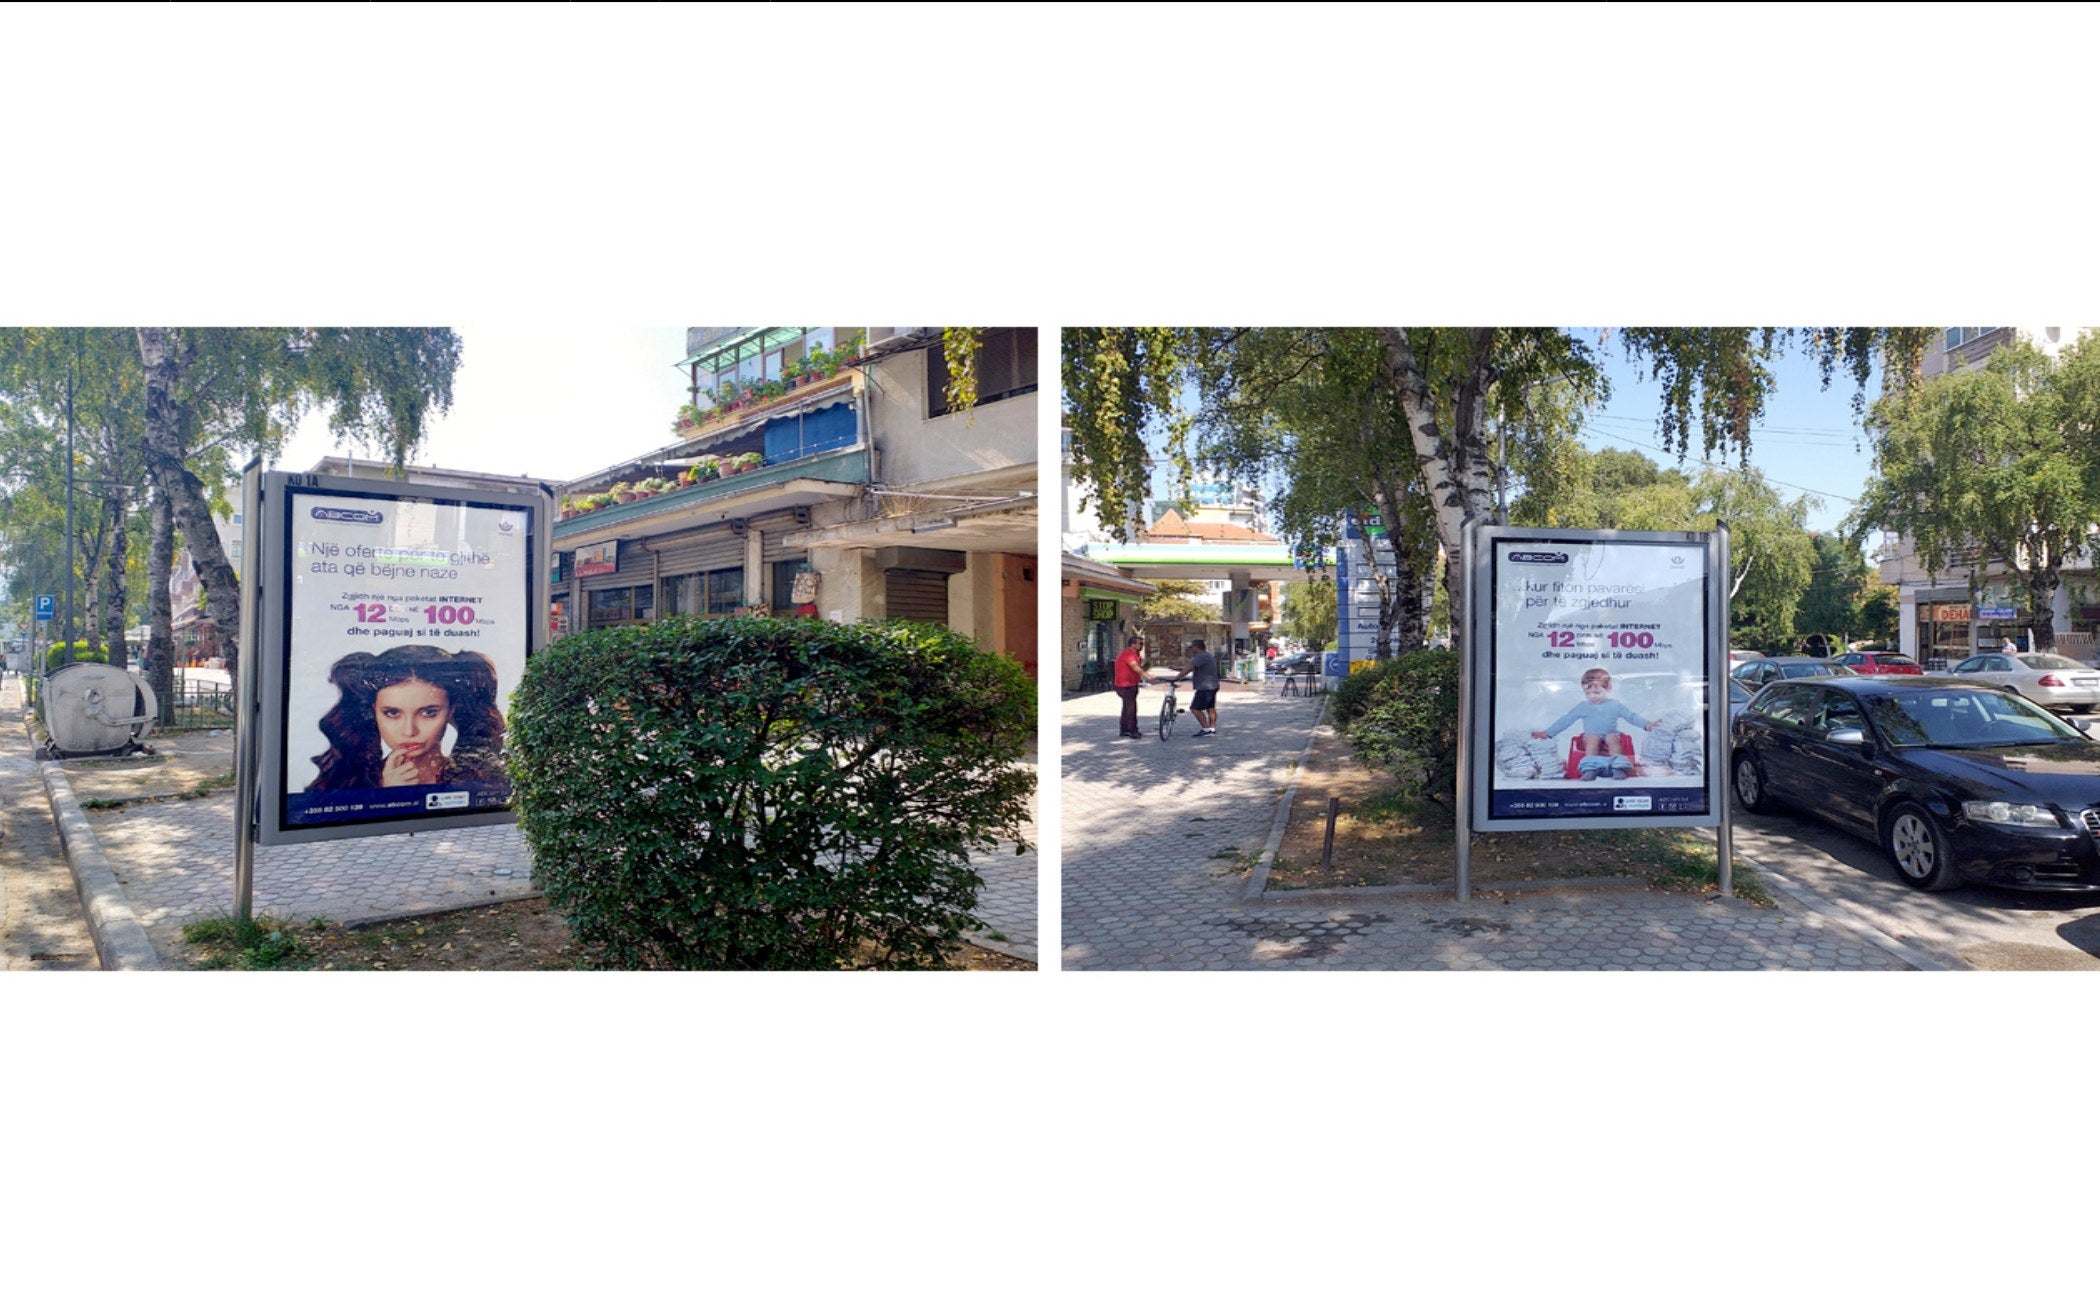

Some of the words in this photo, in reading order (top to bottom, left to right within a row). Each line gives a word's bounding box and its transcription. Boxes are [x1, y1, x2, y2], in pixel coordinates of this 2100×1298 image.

[312, 542, 339, 558] Një
[311, 560, 338, 573] ata
[343, 563, 365, 577] që
[1552, 580, 1583, 592] fiton
[40, 597, 51, 610] P
[439, 596, 483, 604] INTERNET
[1526, 596, 1548, 609] për
[1571, 597, 1632, 610] zgjedhur
[353, 603, 387, 623] 12
[424, 605, 475, 625] 100
[347, 627, 370, 636] dhe
[374, 627, 413, 638] paguaj
[417, 629, 427, 637] si
[444, 629, 480, 637] duash!
[1547, 631, 1575, 648] 12
[1607, 631, 1655, 649] 100
[1542, 651, 1561, 659] dhe
[1563, 651, 1598, 660] paguaj
[1625, 652, 1659, 660] duash!
